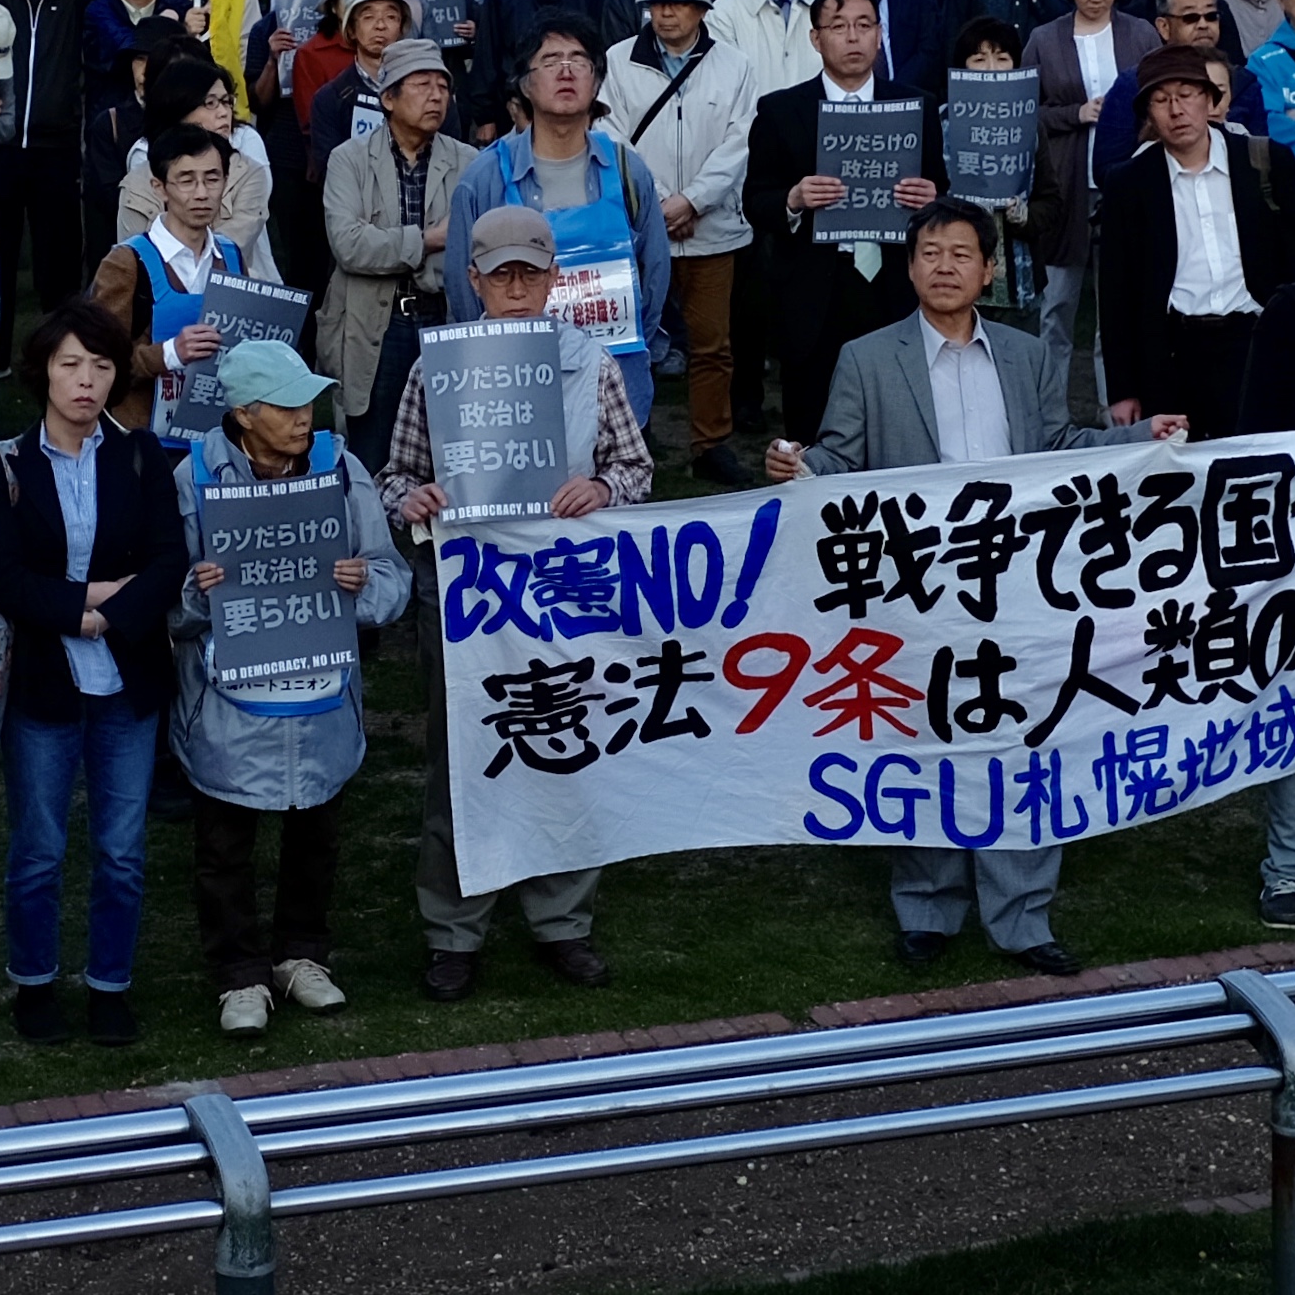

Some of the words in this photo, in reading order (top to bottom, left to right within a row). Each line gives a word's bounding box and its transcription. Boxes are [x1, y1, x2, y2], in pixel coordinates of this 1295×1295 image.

[953, 99, 1036, 119] ウソだらけの
[823, 133, 917, 152] ウソだらけの
[970, 126, 1023, 146] 政治は
[841, 160, 898, 179] 政治は
[957, 150, 1031, 176] 要らない
[815, 231, 828, 241] NO
[204, 310, 294, 344] ウソだらけの
[423, 331, 438, 344] NO
[440, 327, 468, 341] MORE
[469, 325, 486, 339] LIE,
[487, 323, 502, 336] NO
[503, 321, 532, 335] MORE
[533, 320, 554, 333] ABE.
[431, 363, 554, 396] ウソだらけの
[458, 399, 534, 428] 政治は
[442, 438, 556, 477] 要らない
[205, 487, 220, 500] NO
[221, 485, 252, 499] MORE
[253, 484, 271, 498] LIE,
[272, 482, 287, 496] NO
[288, 478, 317, 494] MORE
[318, 473, 340, 488] ABE.
[442, 508, 456, 522] NO
[457, 502, 526, 520] DEMOCRACY,
[527, 502, 542, 516] NO
[212, 517, 340, 554] ウソだらけの
[240, 557, 318, 586] 政治は
[441, 498, 782, 642] 改憲NO!
[222, 590, 342, 637] 要らない
[221, 668, 238, 682] NO
[239, 657, 310, 680] DEMOCRACY,
[312, 652, 328, 667] NO
[330, 650, 355, 665] LIFE.
